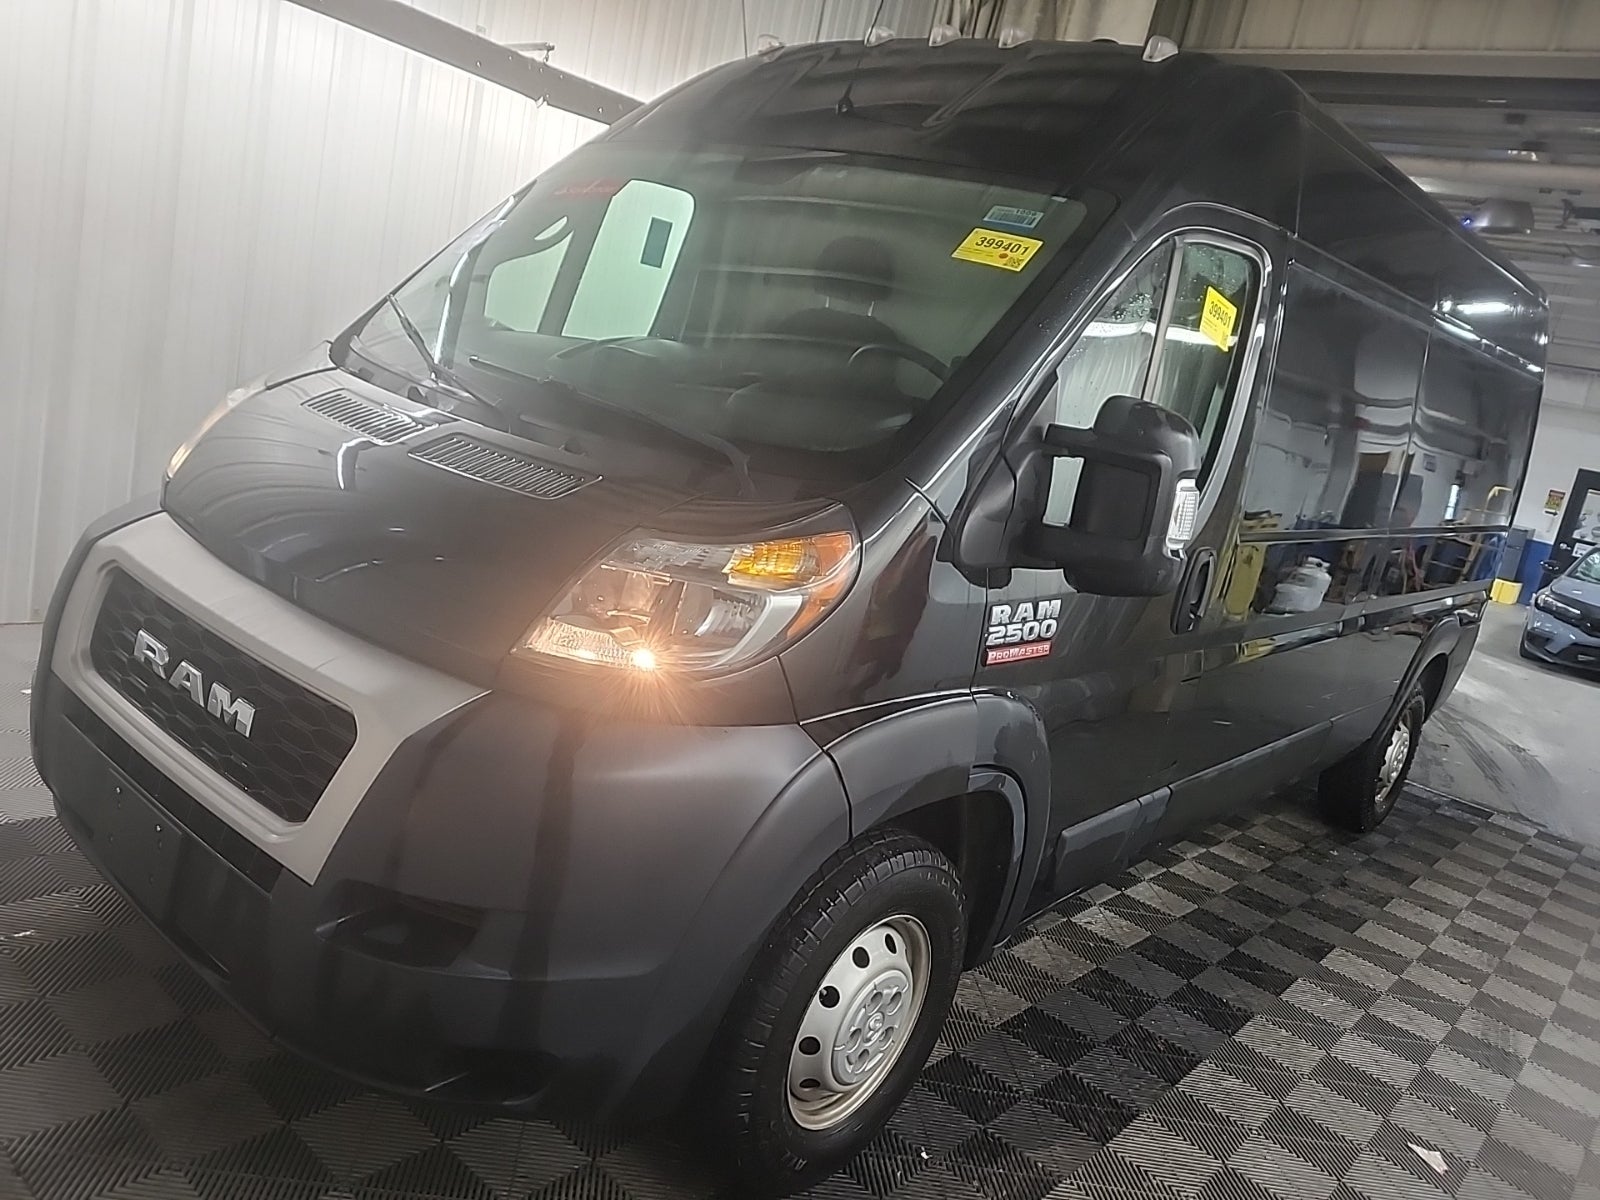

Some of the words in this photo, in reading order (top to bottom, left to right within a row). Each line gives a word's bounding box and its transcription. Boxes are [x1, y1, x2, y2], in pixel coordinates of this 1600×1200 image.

[975, 236, 1030, 256] 399401
[1209, 301, 1231, 329] 399401
[990, 599, 1061, 625] RAM
[986, 619, 1058, 646] 2500
[133, 628, 255, 738] RAM
